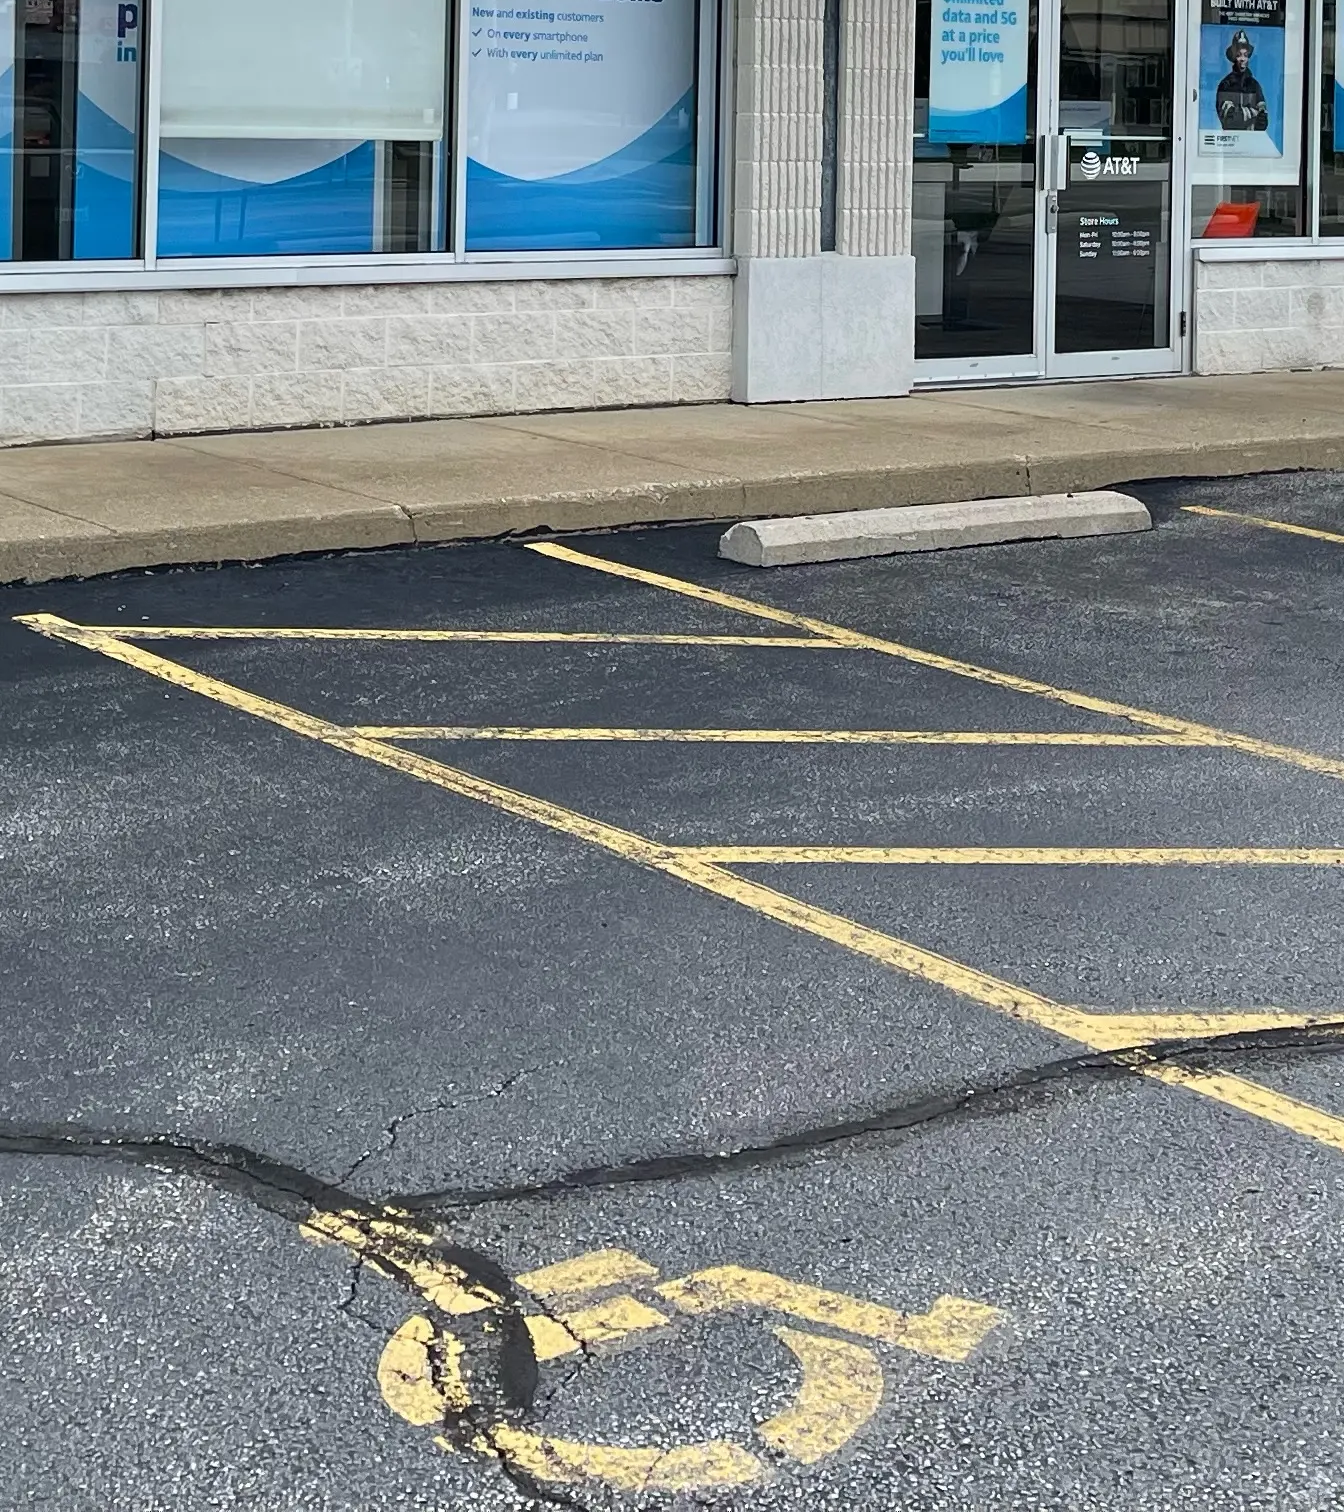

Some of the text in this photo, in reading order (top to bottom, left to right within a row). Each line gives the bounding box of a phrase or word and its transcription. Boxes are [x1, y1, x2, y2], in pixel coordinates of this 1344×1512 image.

[1257, 0, 1278, 10] AT&T
[472, 7, 604, 23] New and existing customers
[942, 8, 1017, 25] data and 5G
[487, 29, 588, 44] On every smartphone
[942, 28, 1000, 46] at a price
[487, 48, 604, 63] With every unlimited plan
[941, 47, 1004, 65] you'll love
[1103, 157, 1140, 175] AT&T
[1079, 217, 1119, 226] Store Hours
